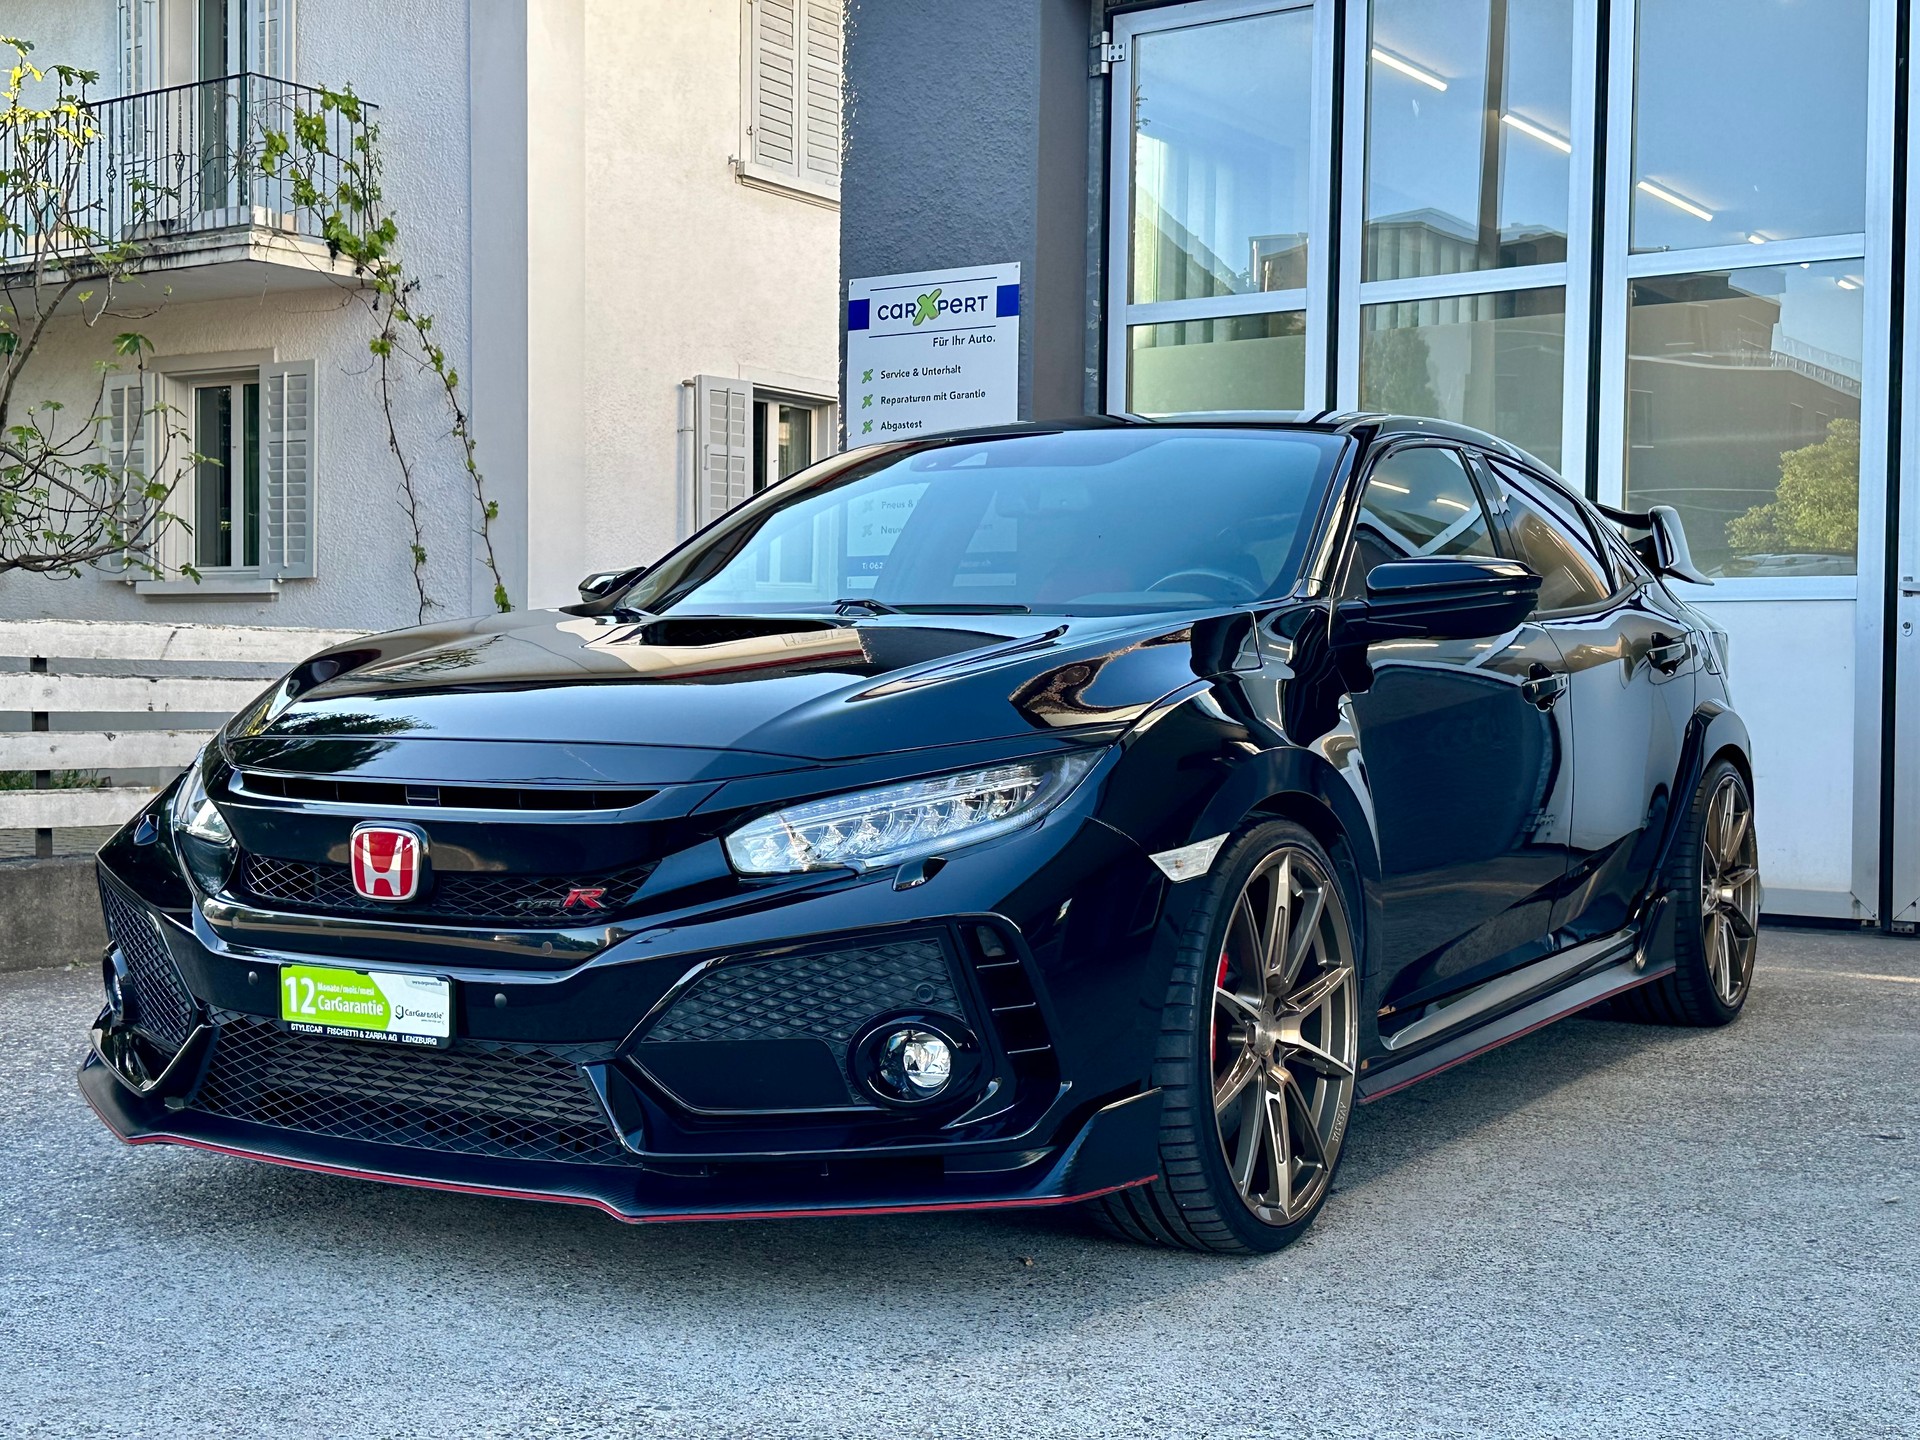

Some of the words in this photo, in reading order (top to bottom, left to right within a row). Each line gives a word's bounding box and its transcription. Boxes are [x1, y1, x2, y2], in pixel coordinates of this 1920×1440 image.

[932, 337, 949, 347] Für
[952, 335, 965, 346] Ihr
[968, 334, 996, 345] Auto.
[880, 369, 910, 379] Service
[912, 367, 919, 377] &
[921, 364, 961, 376] Unterhalt
[880, 394, 931, 406] Reparaturen
[933, 391, 948, 401] mit
[949, 389, 986, 400] Garantie
[880, 420, 922, 432] Abgastest
[562, 887, 608, 909] R
[285, 976, 316, 1015] 12
[317, 994, 384, 1017] CarGarantie
[290, 1023, 323, 1033] STYLECAR
[365, 1031, 387, 1041] ZARRA
